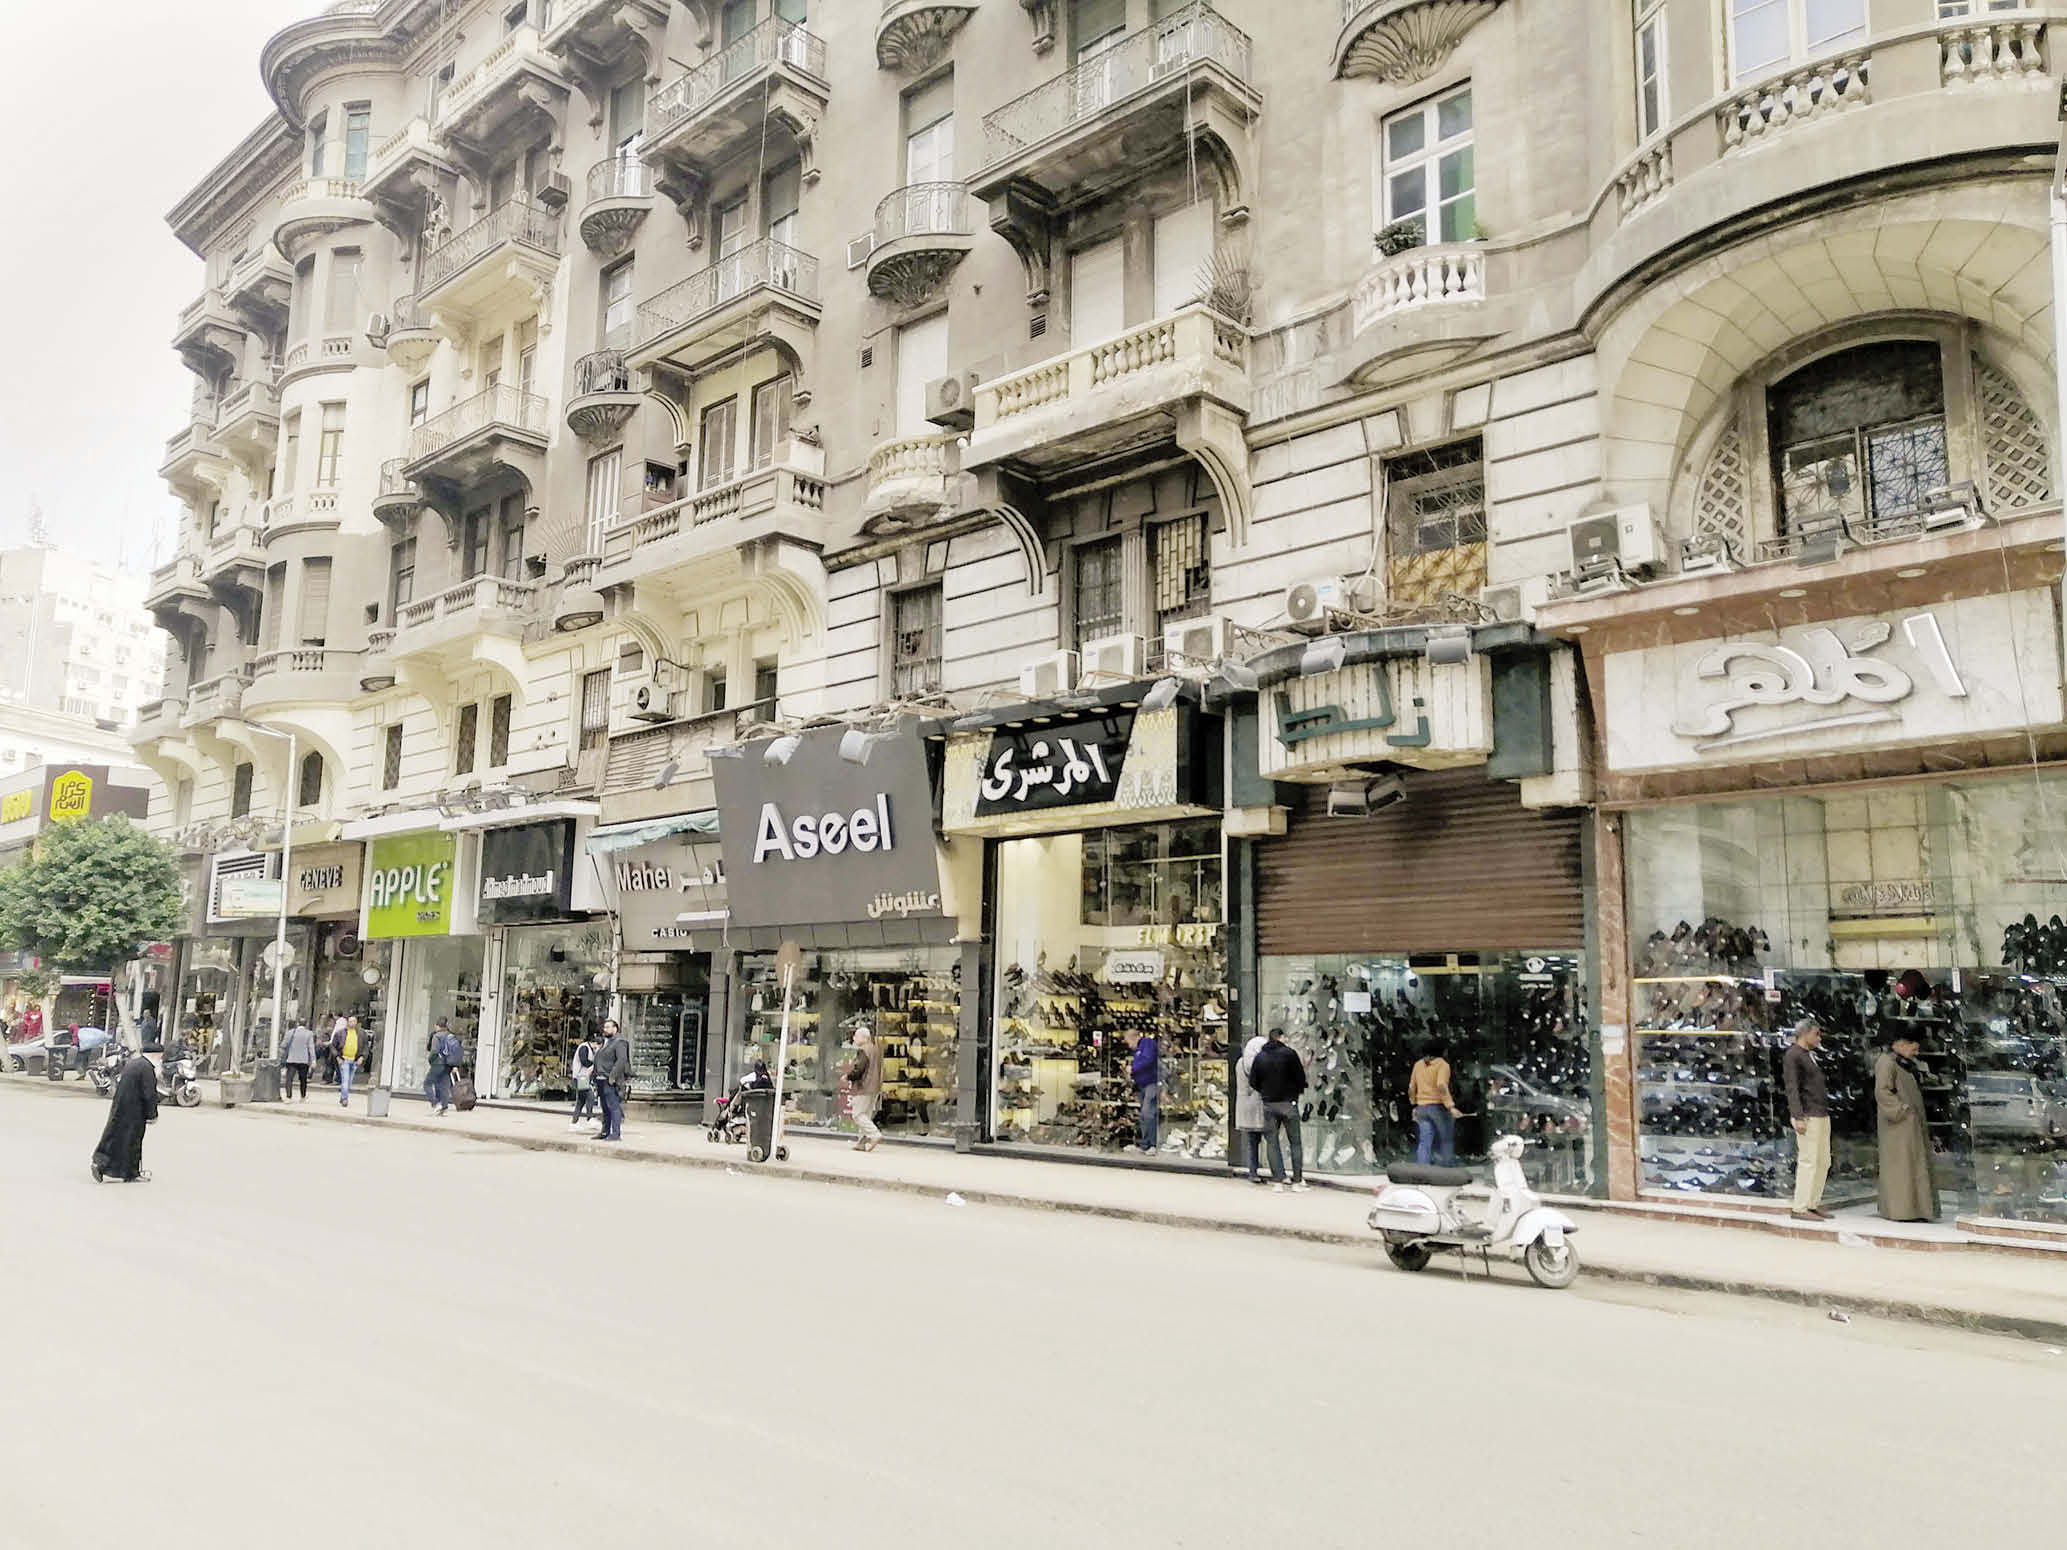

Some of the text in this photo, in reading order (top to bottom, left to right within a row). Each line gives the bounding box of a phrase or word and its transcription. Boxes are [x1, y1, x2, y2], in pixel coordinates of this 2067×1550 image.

[753, 793, 893, 863] Aseel
[369, 862, 442, 907] APPLE
[615, 861, 673, 892] Maher
[651, 927, 688, 938] CASIO
